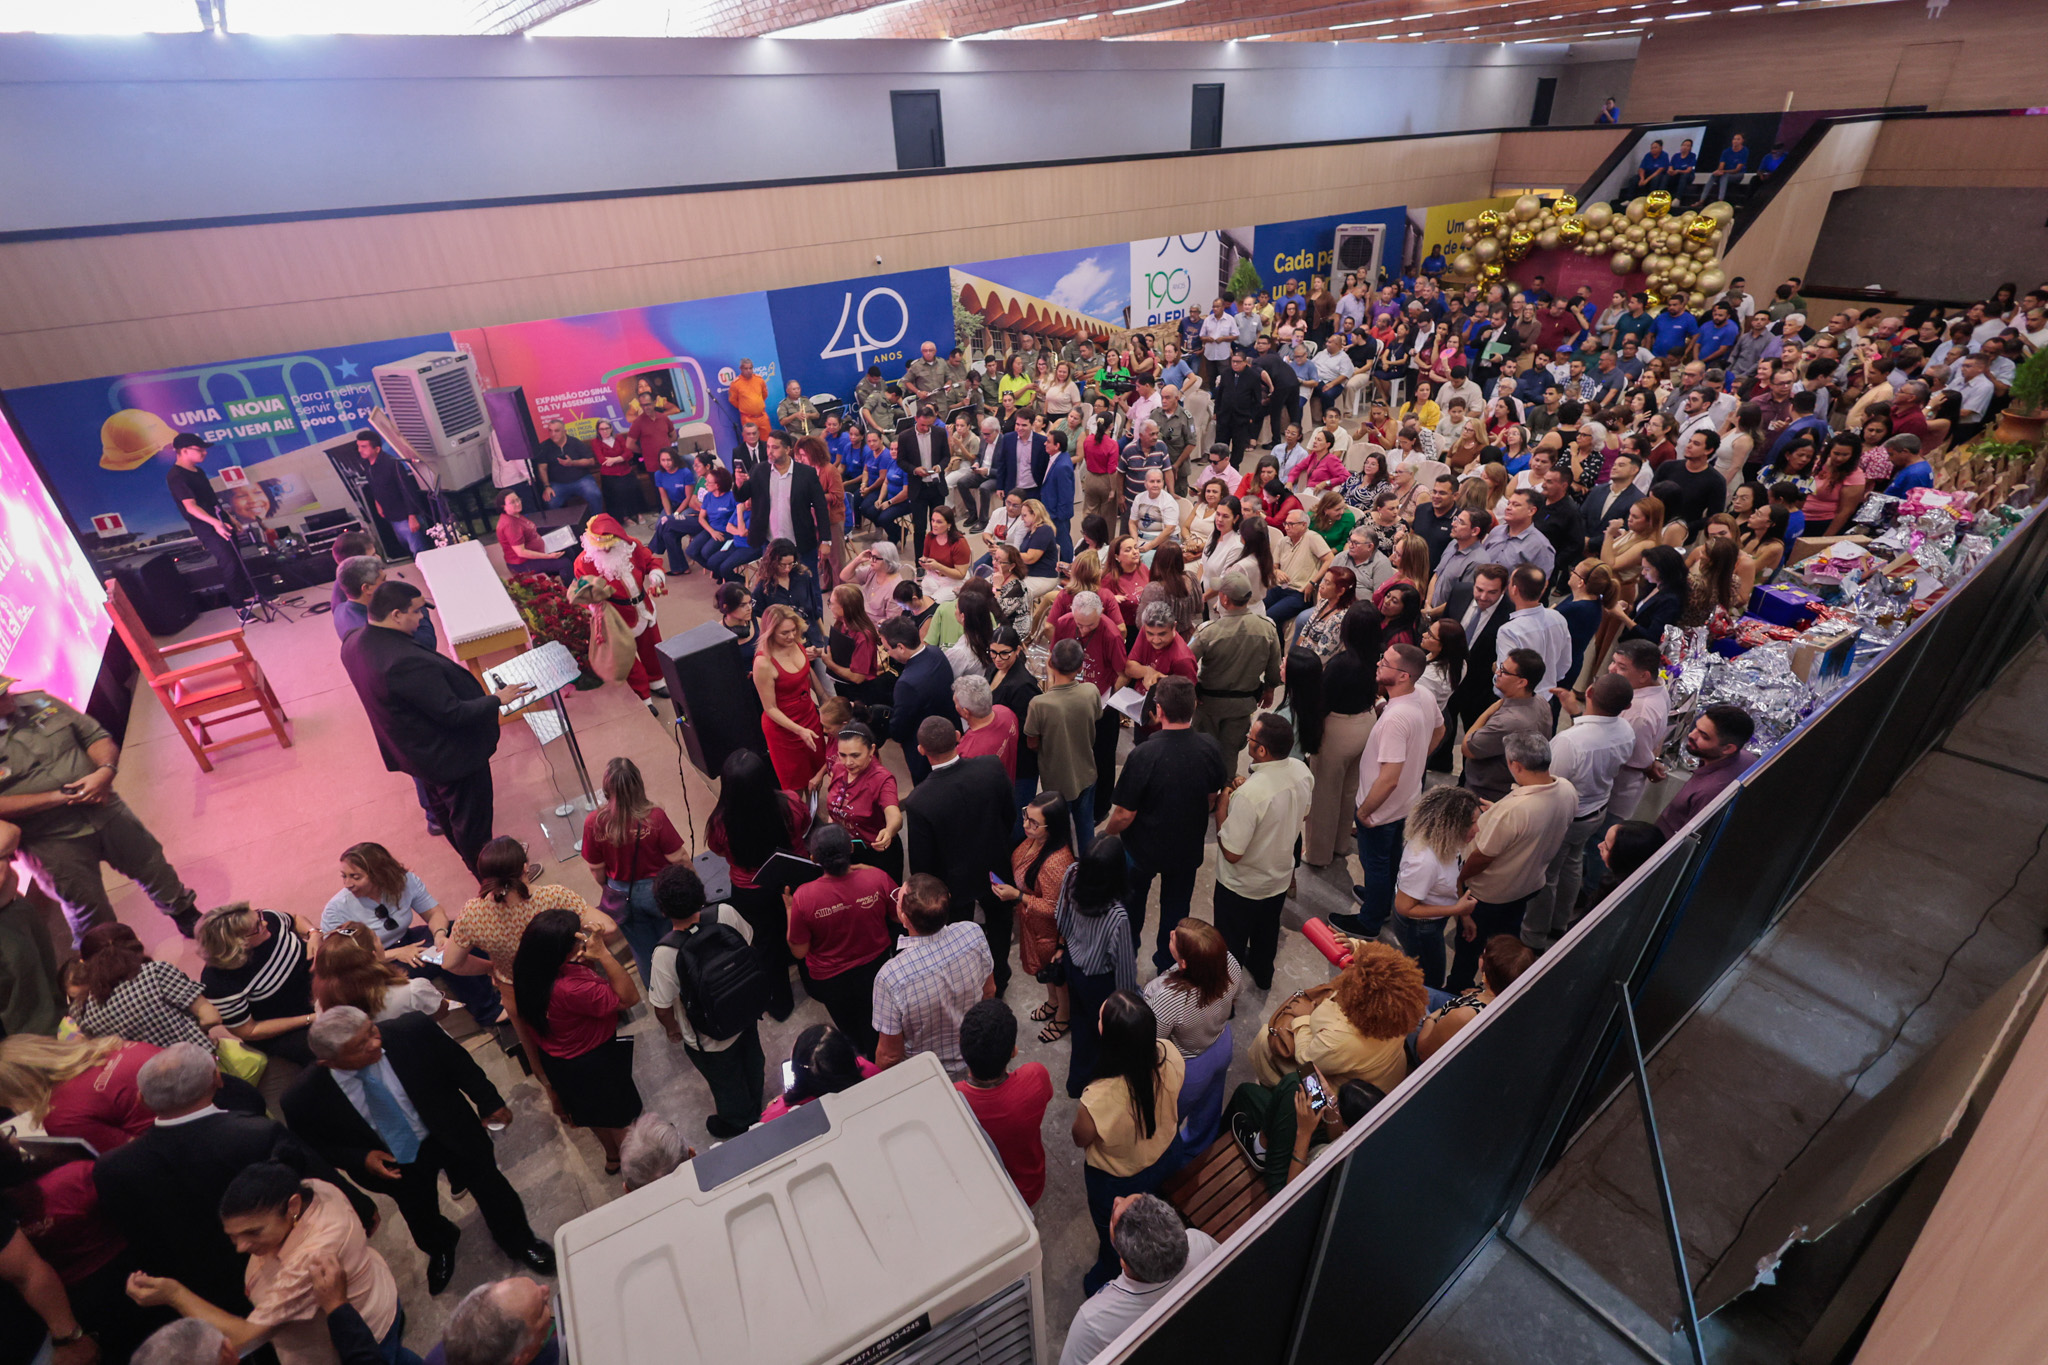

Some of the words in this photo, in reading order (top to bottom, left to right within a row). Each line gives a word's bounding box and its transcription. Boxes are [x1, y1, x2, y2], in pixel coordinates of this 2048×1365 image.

[1444, 240, 1458, 254] de
[1274, 249, 1314, 274] Cada
[1145, 268, 1191, 310] 190
[820, 287, 908, 372] 40
[873, 351, 903, 364] ANOS
[290, 394, 324, 408] para
[326, 384, 372, 400] melhor
[535, 392, 578, 406] EXPANSÃO
[590, 386, 612, 396] SINAL
[537, 404, 550, 413] DA
[550, 402, 560, 410] TV
[562, 395, 607, 408] ASSEMBLEIA
[172, 408, 222, 427] UMA
[228, 398, 286, 418] NOVA
[295, 400, 332, 416] servir
[334, 400, 353, 411] ao
[195, 428, 234, 442] EPI
[233, 422, 274, 437] VEM
[274, 417, 296, 432] AÍ!
[300, 415, 336, 431] povo
[338, 410, 356, 422] do
